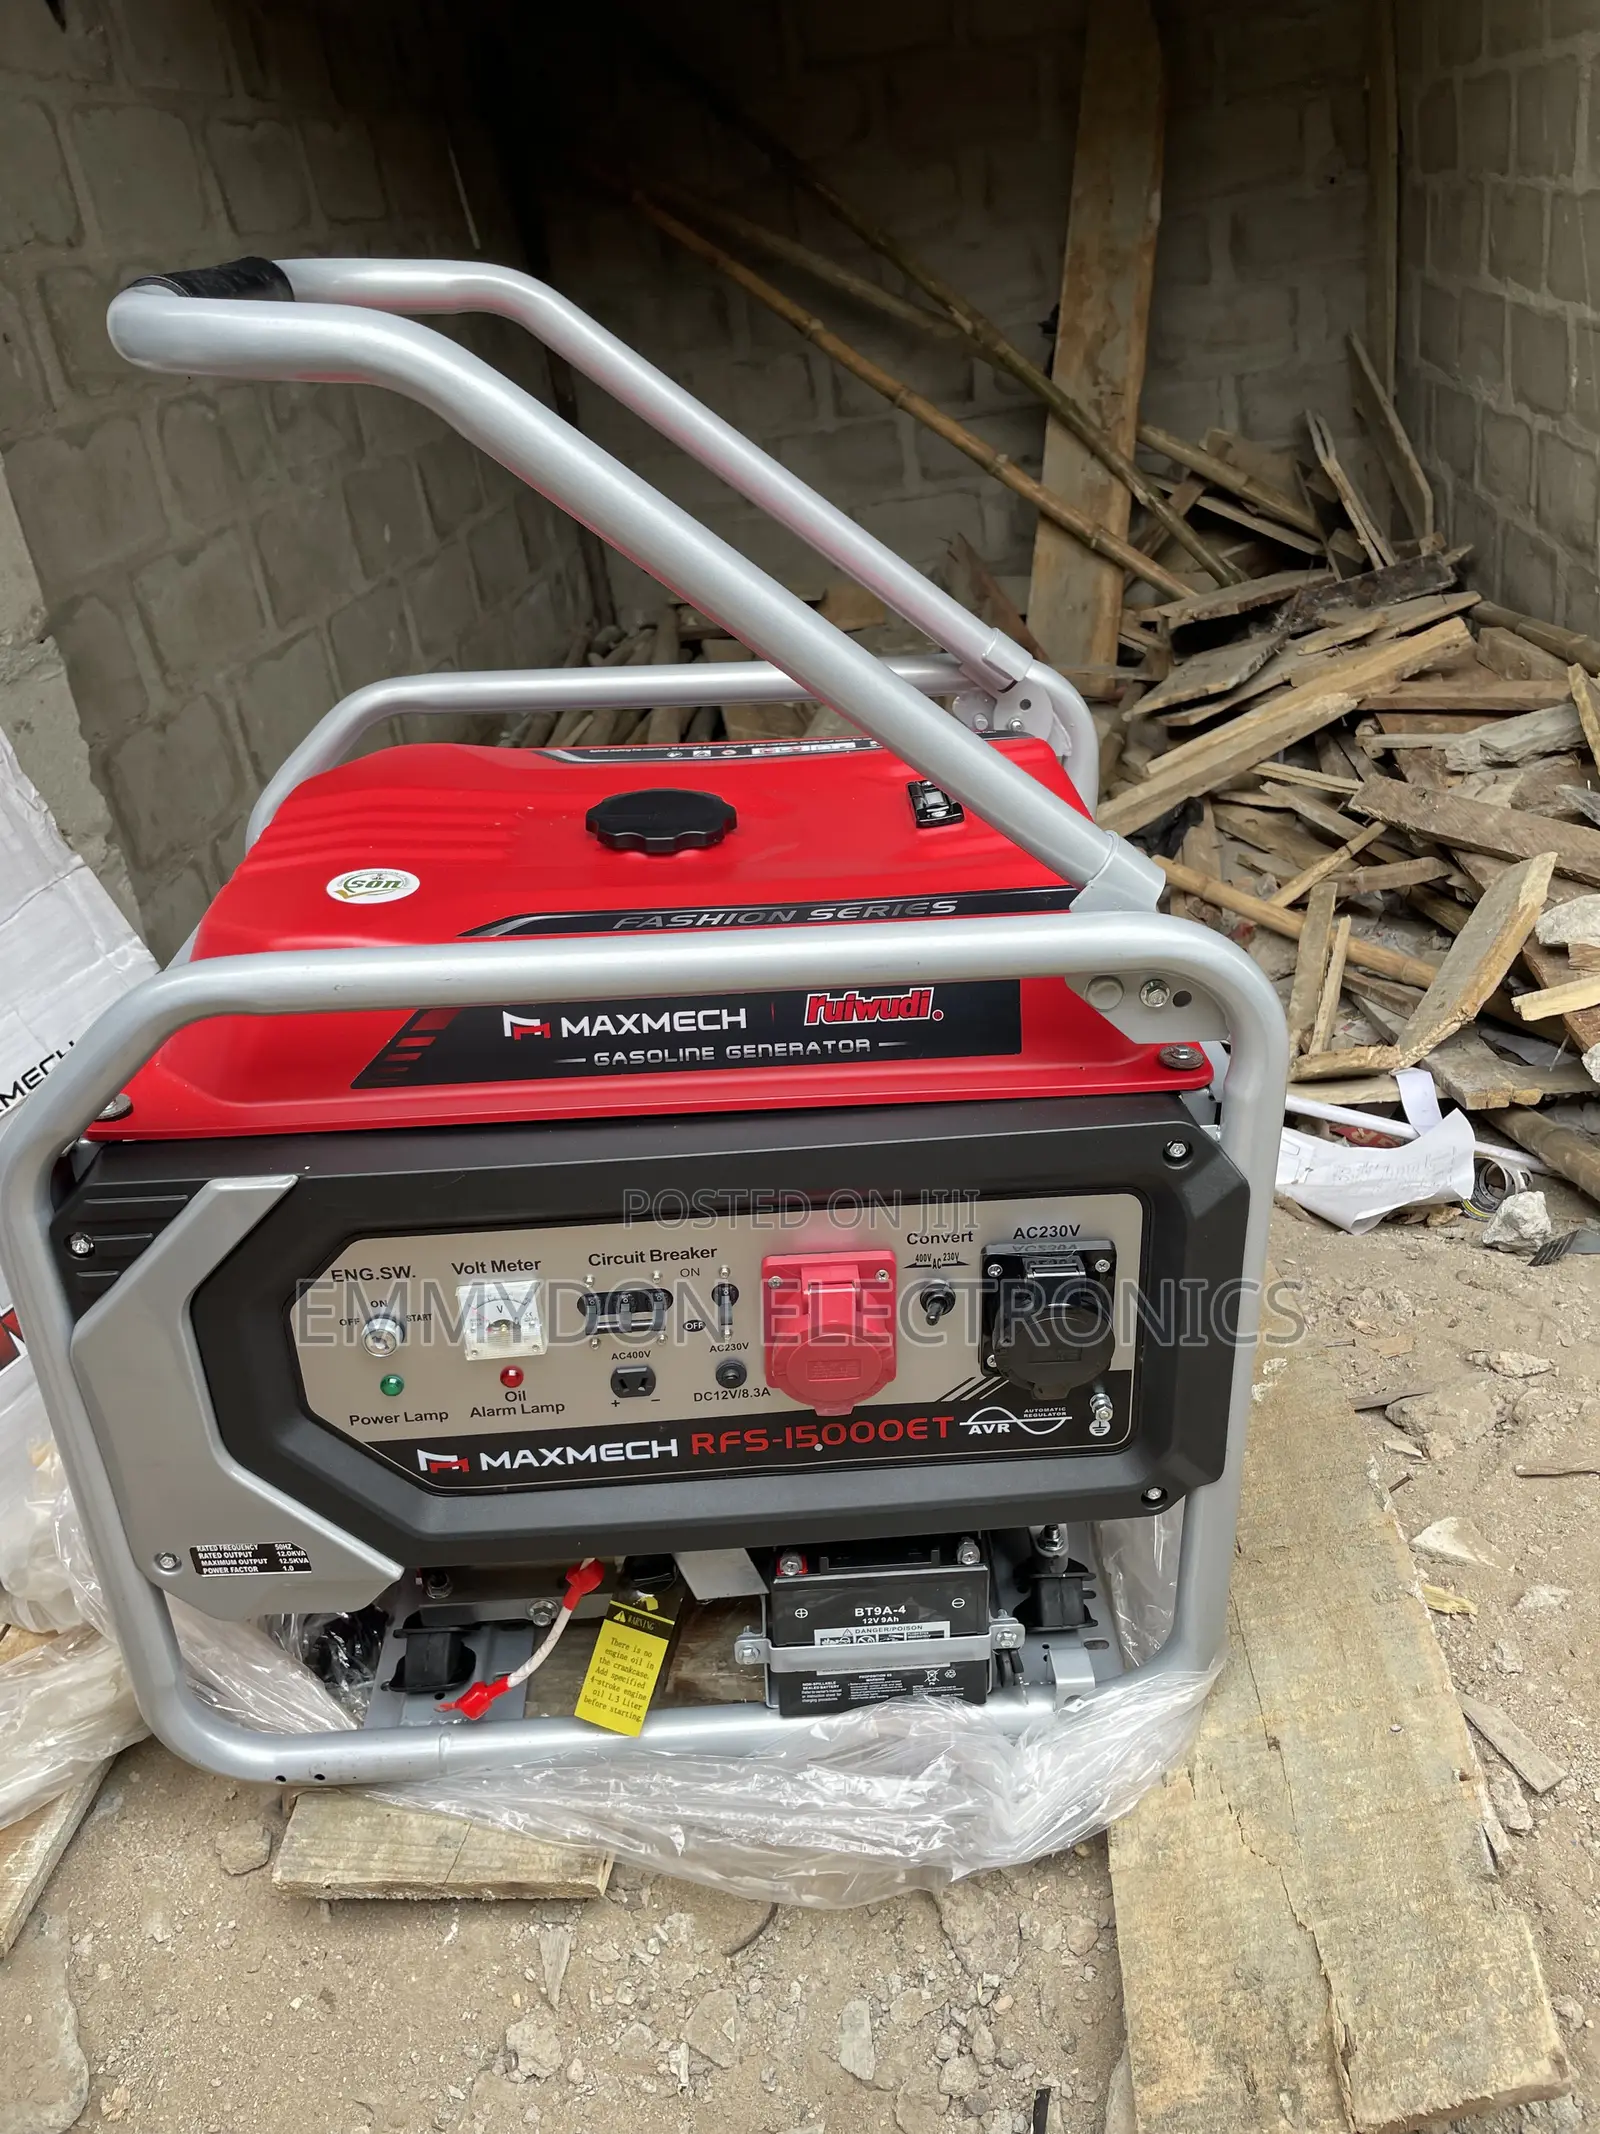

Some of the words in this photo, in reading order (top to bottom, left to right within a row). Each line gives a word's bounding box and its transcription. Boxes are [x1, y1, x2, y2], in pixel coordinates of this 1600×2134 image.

[613, 909, 800, 930] FASHION
[806, 900, 958, 921] SERIES
[561, 1008, 747, 1038] MAXMECH
[594, 1045, 715, 1067] GASOLINE
[725, 1038, 871, 1059] GENERATOR
[906, 1230, 974, 1245] Convert
[1012, 1224, 1081, 1240] AC230V
[588, 1250, 646, 1267] Circuit
[650, 1246, 718, 1263] Breaker
[915, 1253, 932, 1263] 400V
[932, 1258, 942, 1270] AC
[943, 1252, 960, 1262] 230V
[331, 1265, 416, 1282] ENG.SW.
[451, 1261, 488, 1276] Volt
[491, 1258, 541, 1274] Meter
[679, 1267, 700, 1278] ON
[370, 1299, 388, 1309] ON
[339, 1318, 361, 1327] OFF
[406, 1313, 433, 1323] START
[685, 1322, 704, 1332] OFF
[709, 1342, 750, 1353] AC230V
[611, 1350, 651, 1361] AC400V
[504, 1390, 527, 1402] Oil
[693, 1387, 771, 1403] DC12V/8.3A
[470, 1406, 517, 1418] Alarm
[521, 1402, 566, 1416] Lamp
[349, 1414, 400, 1426] Power
[404, 1410, 449, 1424] Lamp
[968, 1423, 1011, 1435] AVR
[479, 1438, 679, 1471] MAXMECH
[691, 1416, 955, 1455] RFS-15000ET
[198, 1552, 223, 1560] RATED
[223, 1551, 253, 1559] OUTPUT
[201, 1559, 238, 1567] MAXIMUM
[854, 1605, 907, 1617] BT9A-4
[862, 1617, 880, 1625] 12V
[855, 1625, 923, 1634] DANGER/POISON
[611, 1637, 630, 1651] There
[633, 1645, 642, 1654] is
[604, 1648, 628, 1661] engine
[630, 1657, 643, 1666] oil
[646, 1661, 654, 1670] in
[599, 1656, 611, 1666] the
[612, 1663, 649, 1680] crankcase.
[590, 1676, 620, 1693] 4-stroke
[595, 1666, 608, 1676] Add
[610, 1673, 646, 1689] specified
[583, 1695, 607, 1710] before
[592, 1688, 605, 1697] oil
[622, 1698, 643, 1711] Liter
